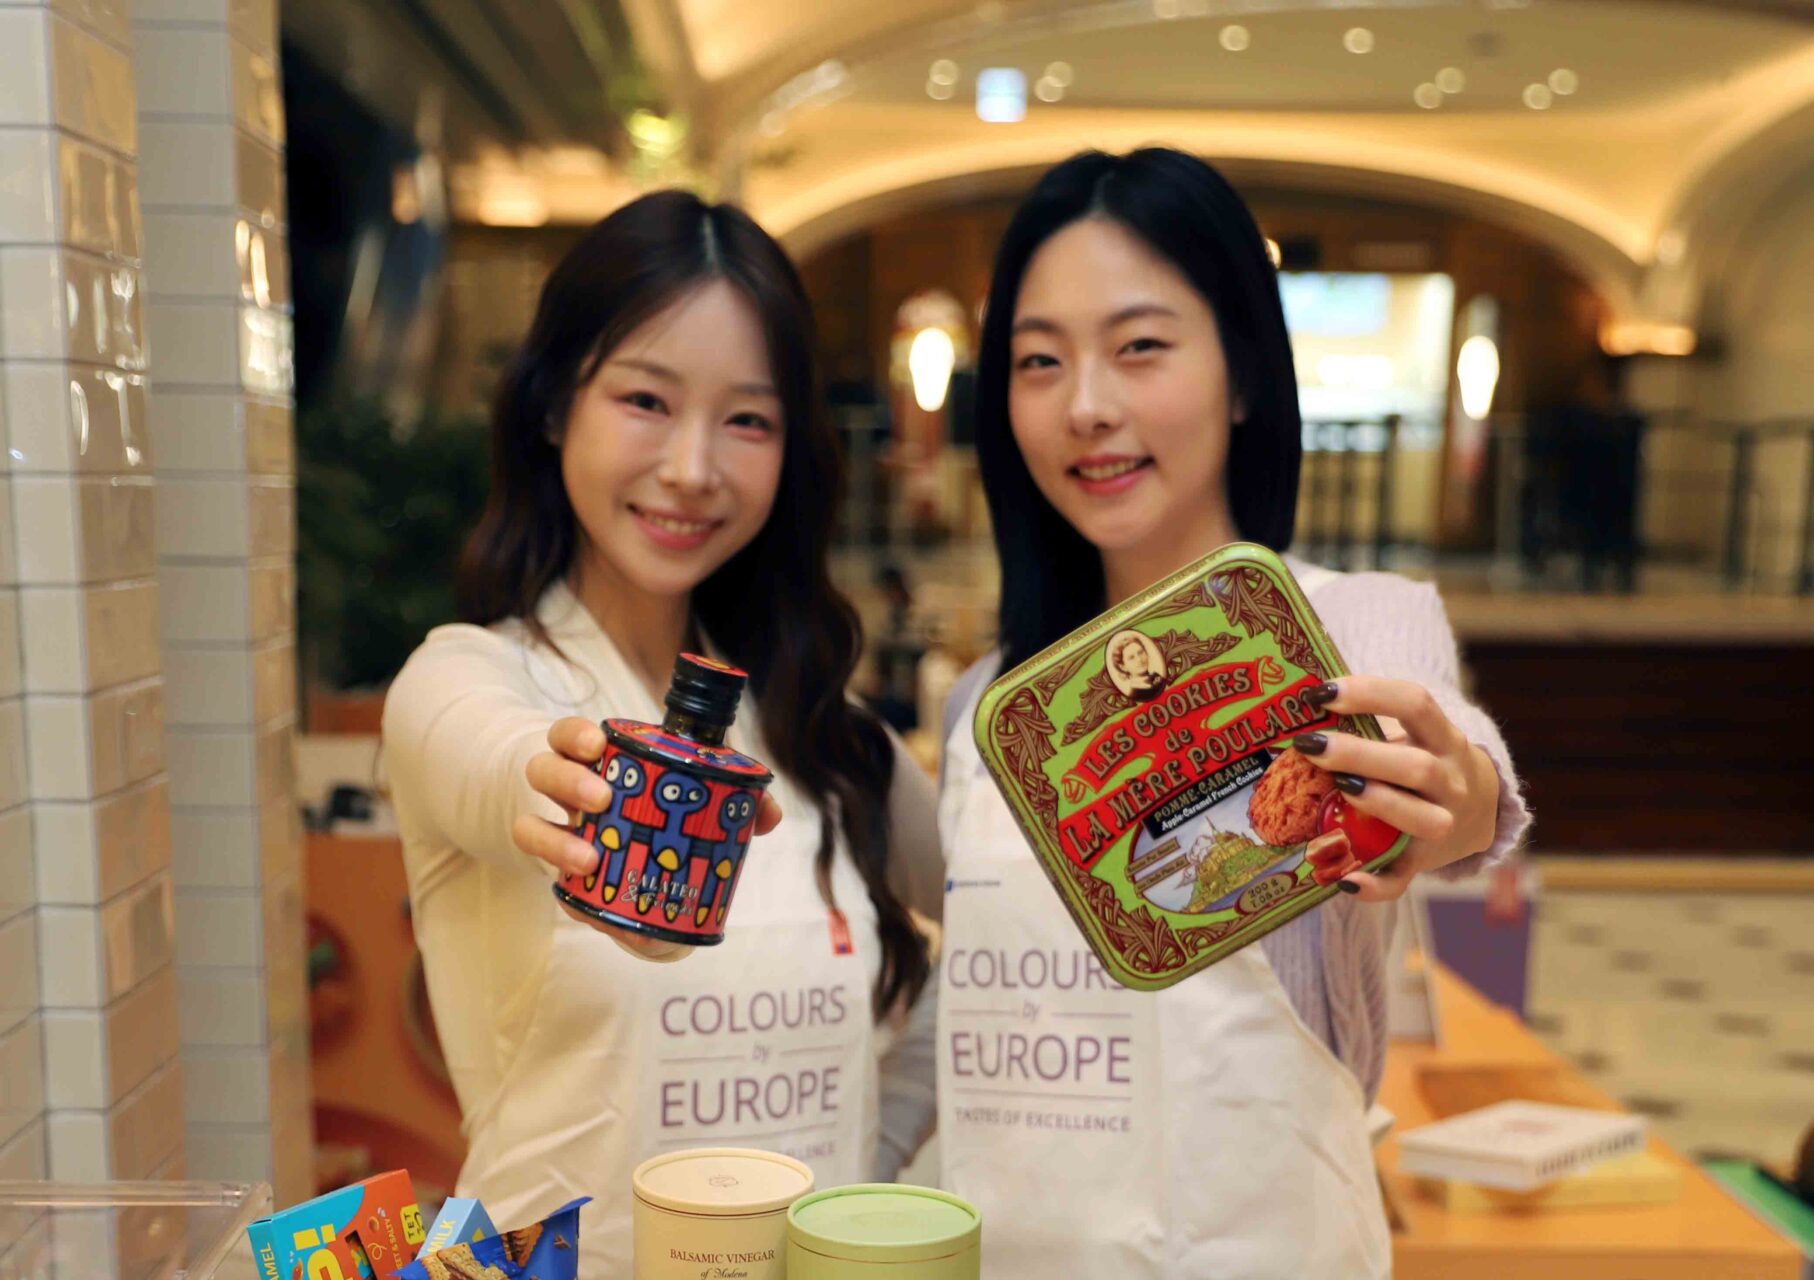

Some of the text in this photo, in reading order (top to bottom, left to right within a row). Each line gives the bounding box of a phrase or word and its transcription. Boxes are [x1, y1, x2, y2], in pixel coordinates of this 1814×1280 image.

[1082, 666, 1252, 780] LES COOKIES
[1164, 726, 1193, 753] de
[1212, 779, 1237, 802] French
[1235, 767, 1263, 786] Cookies
[1063, 813, 1114, 862] LA
[1113, 764, 1187, 825] MÈRE
[628, 868, 697, 899] GALATEO
[1249, 880, 1268, 898] 200
[659, 985, 846, 1037] COLOURS
[1022, 1000, 1040, 1022] by
[752, 1042, 770, 1063] by
[951, 1032, 1132, 1085] EUROPE
[659, 1065, 841, 1128] EUROPE
[955, 1106, 1131, 1132] TASTES OF EXCELLENCE
[670, 1249, 775, 1263] BALSAMIC VINEGAR
[700, 1268, 748, 1280] of Modena
